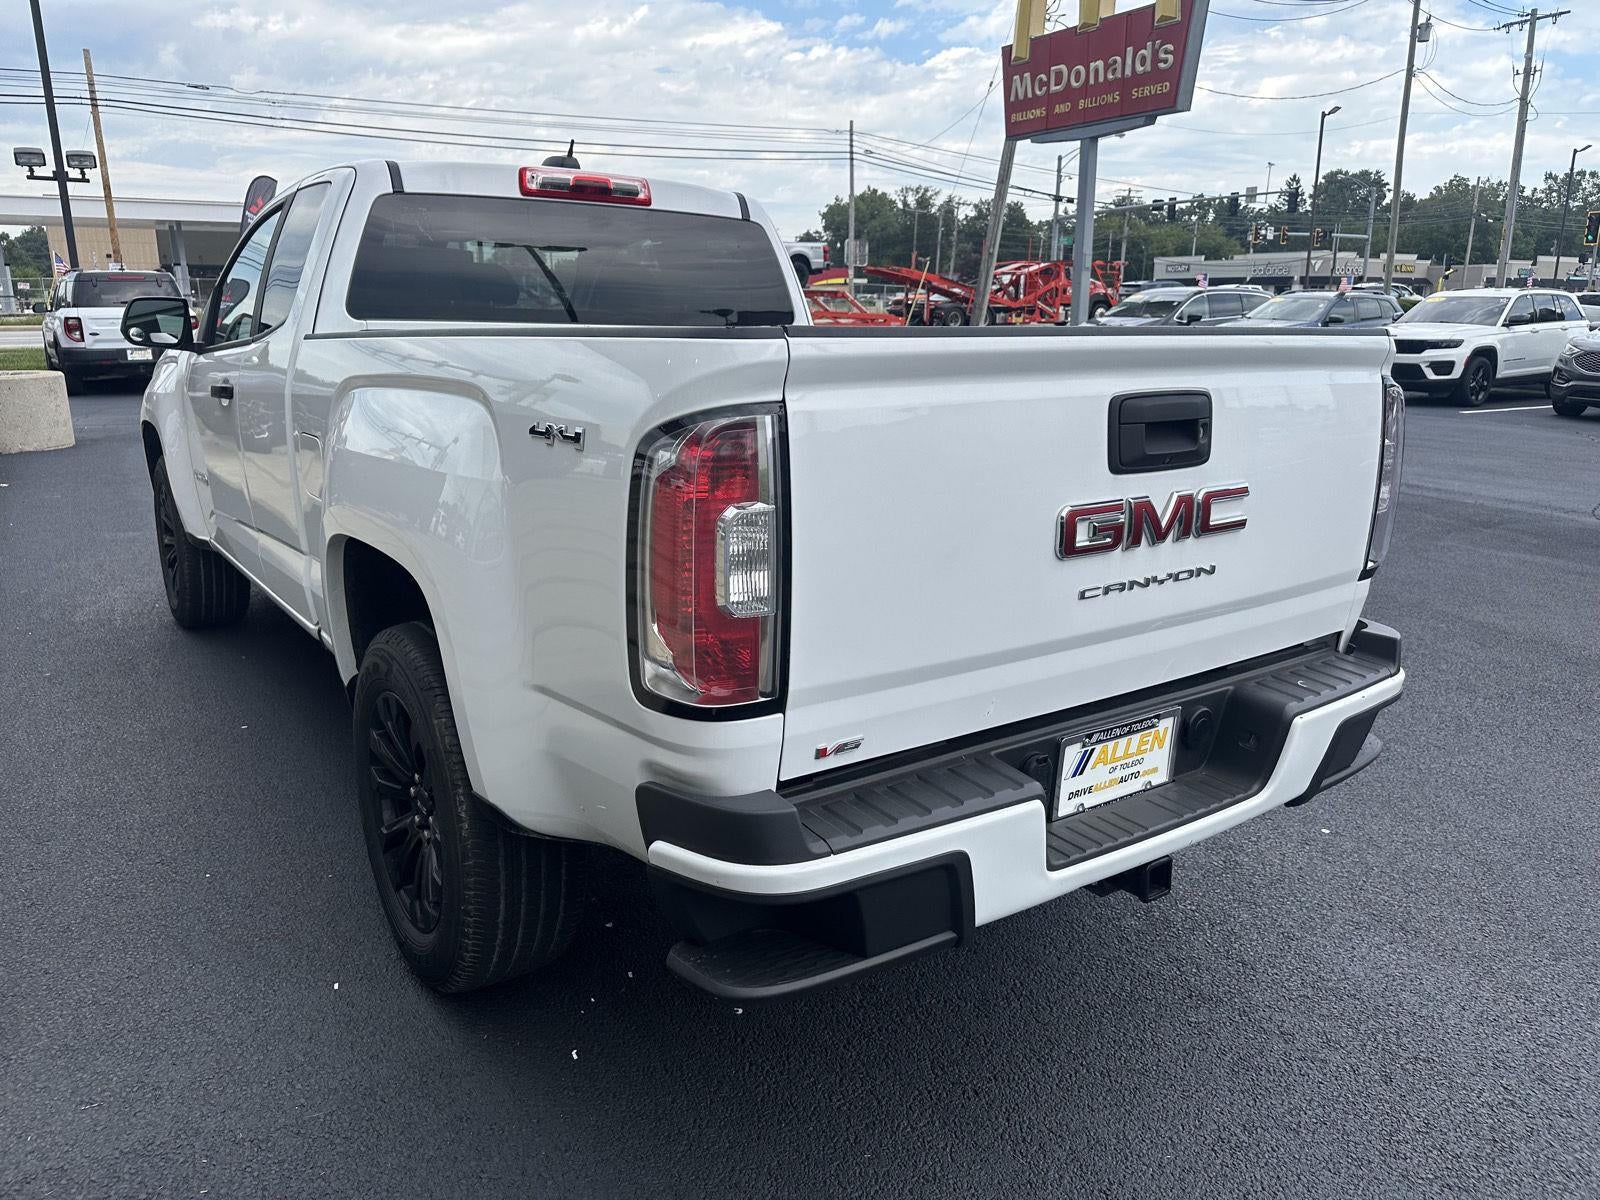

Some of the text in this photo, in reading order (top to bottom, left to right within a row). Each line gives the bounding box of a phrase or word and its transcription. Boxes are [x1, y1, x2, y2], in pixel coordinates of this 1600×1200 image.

[1010, 39, 1175, 102] McDonald's
[1010, 81, 1170, 123] BILLIONS AND BILLIONS SERVED
[1054, 481, 1250, 560] GMC
[1077, 564, 1217, 600] CANYON
[814, 734, 865, 760] V6
[1097, 718, 1154, 741] ALLEN OF TOLEDO
[1091, 726, 1168, 770] ALLEN
[1108, 757, 1145, 774] OF TOLEDO
[1067, 766, 1159, 801] DRIVEALLENAUTO.com
